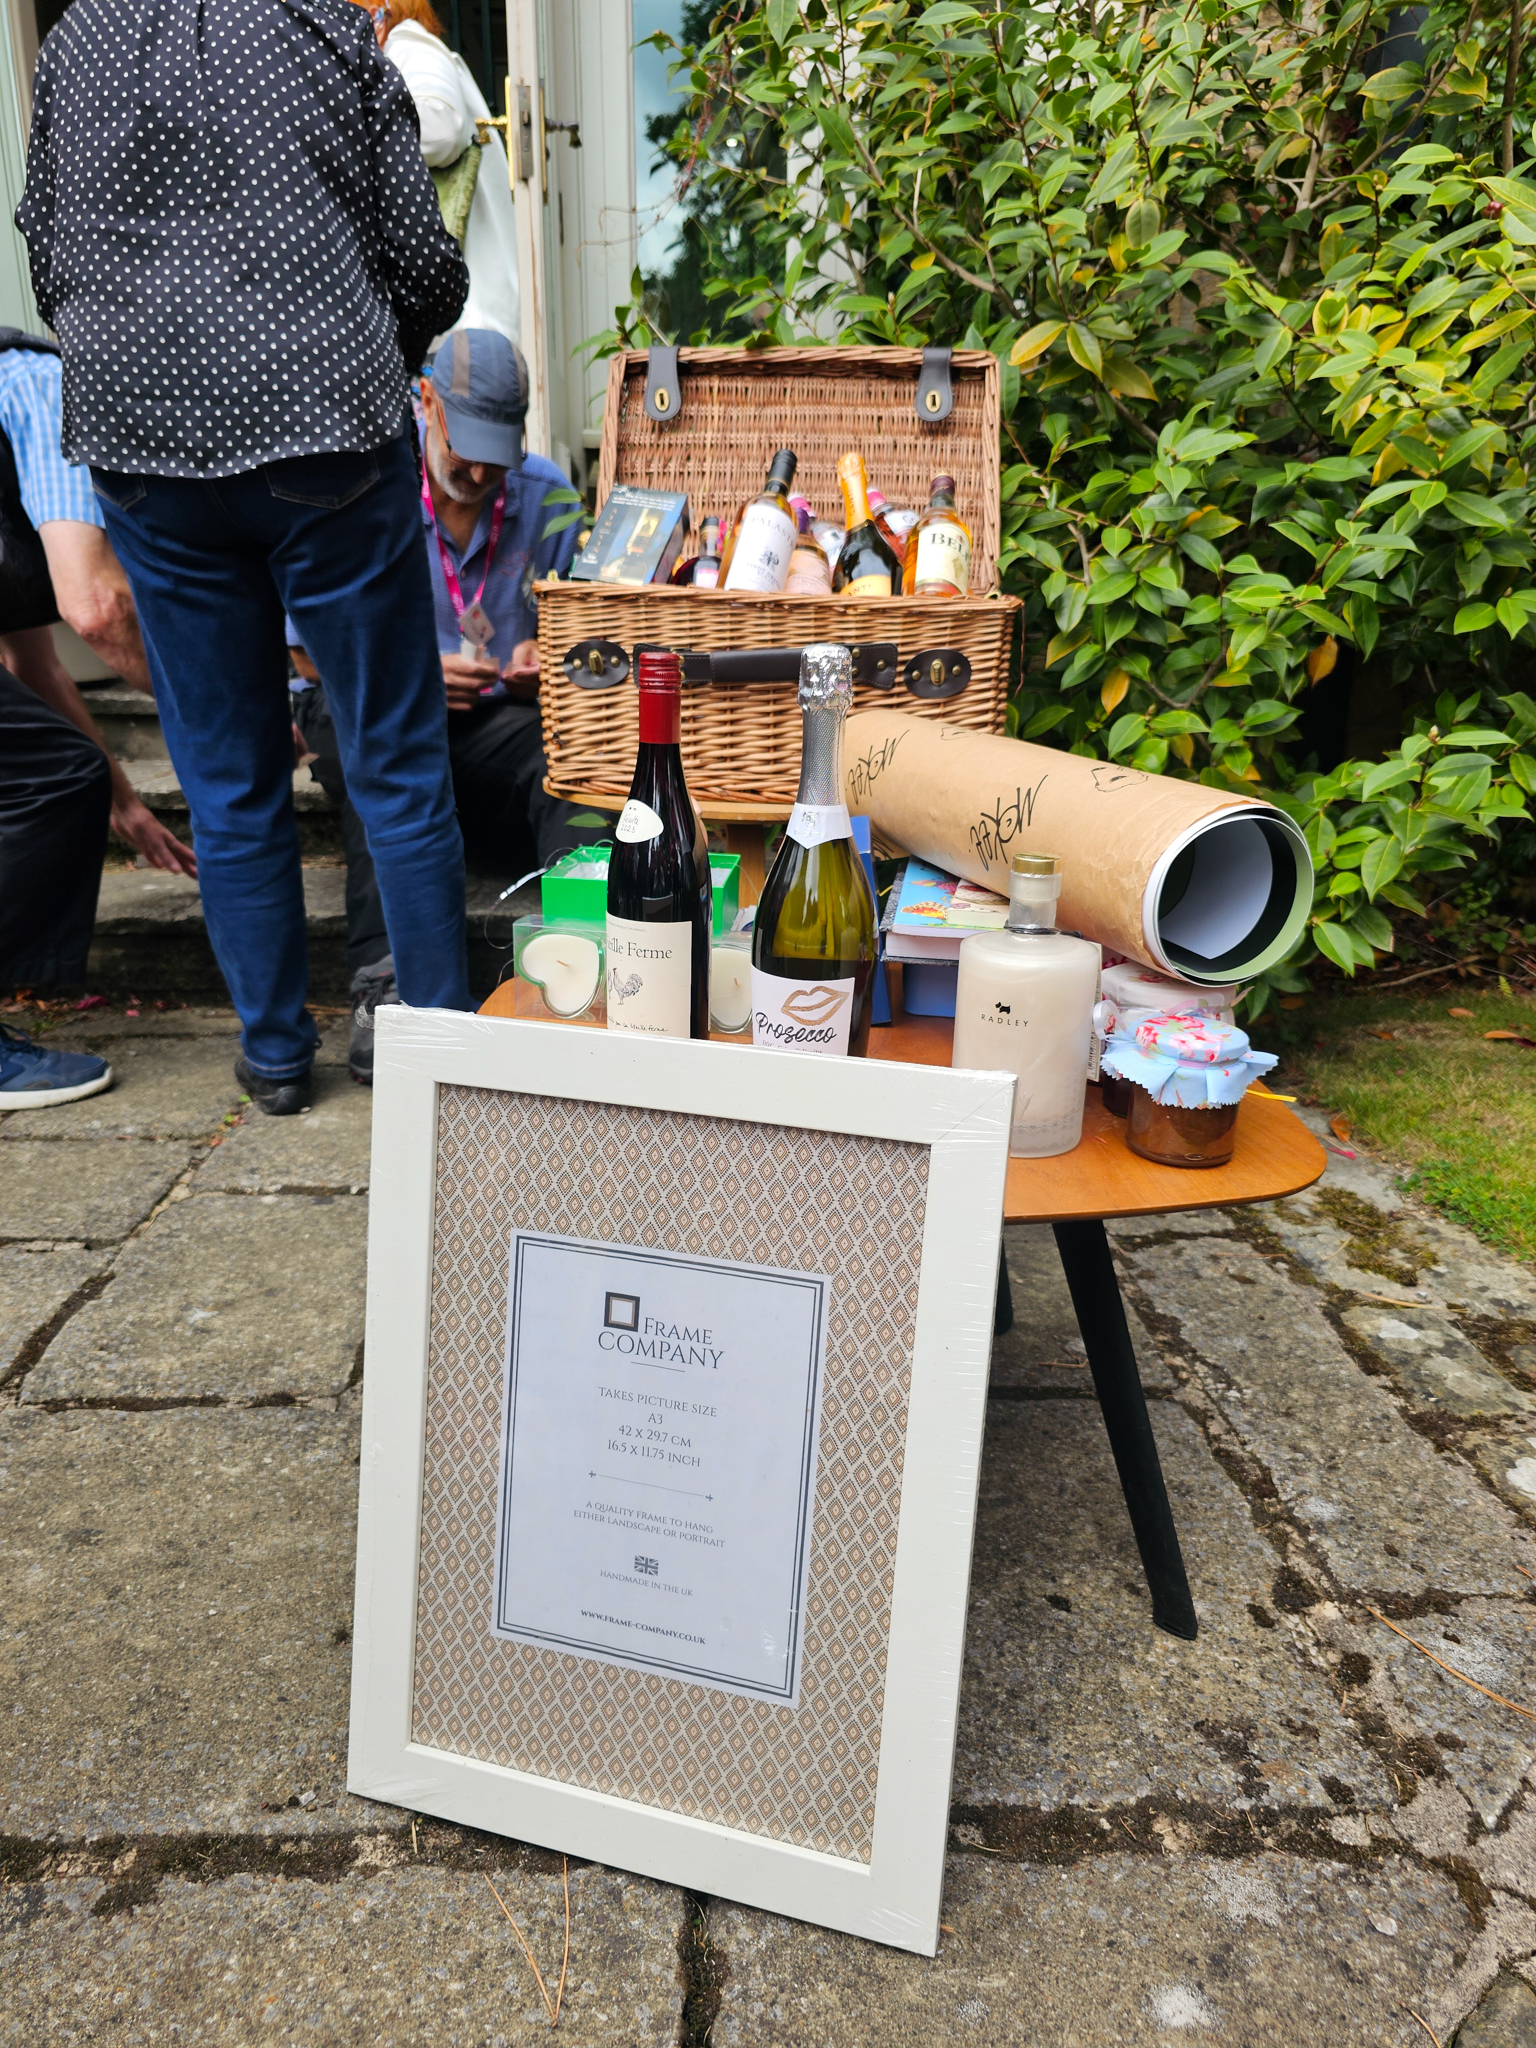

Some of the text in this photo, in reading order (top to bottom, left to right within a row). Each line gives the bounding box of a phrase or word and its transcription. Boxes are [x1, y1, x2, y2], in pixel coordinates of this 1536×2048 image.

[846, 584, 871, 597] ANTI
[627, 941, 673, 959] Ferme
[755, 1012, 837, 1044] Prosecco
[981, 1013, 1029, 1028] RADLEY
[644, 1317, 712, 1345] FRAME
[598, 1331, 725, 1369] COMPANY
[598, 1386, 718, 1418] TAKES PICTURE SIZE
[647, 1412, 664, 1425] A3
[618, 1424, 692, 1448] 42 X 29.7 CM
[607, 1439, 701, 1467] 16.5 X 11.75 INCH
[573, 1509, 726, 1548] EITHER LANDSCAPE OR PORTRAIT
[586, 1500, 714, 1534] A QUALITY FRAME TO HANG
[600, 1569, 694, 1597] HANDMADE IN THE UK
[580, 1609, 706, 1645] WWW.FRAME-COMPANY.CO.UK
